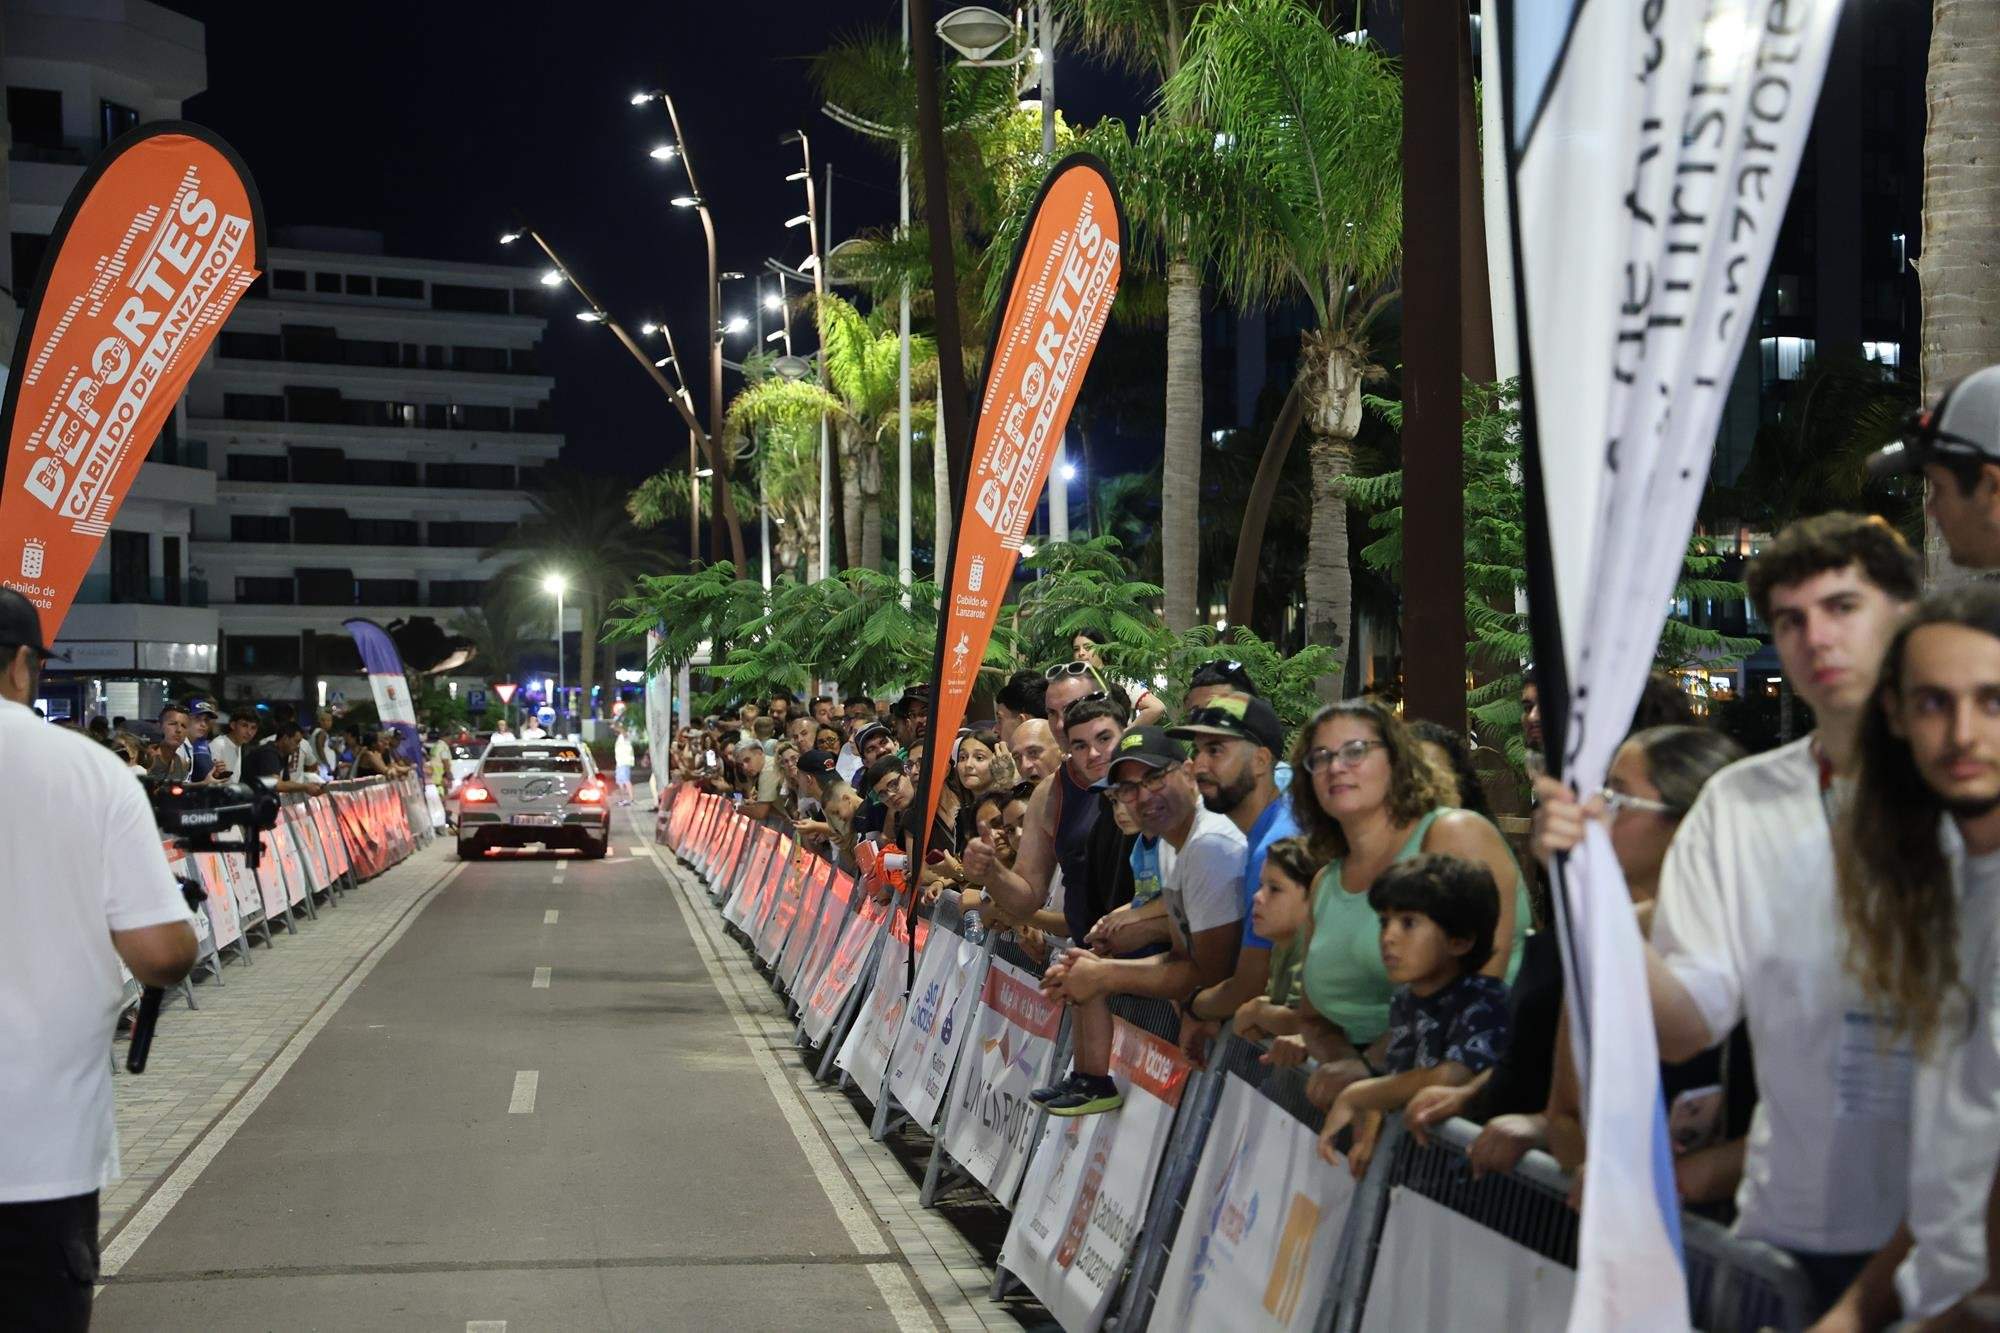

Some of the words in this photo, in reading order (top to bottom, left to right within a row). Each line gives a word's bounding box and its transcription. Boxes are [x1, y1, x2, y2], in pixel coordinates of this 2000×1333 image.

[24, 190, 217, 510] DEPORTES
[41, 420, 81, 487] SERVICIO
[76, 358, 115, 421] INSULAR
[110, 337, 128, 360] DE
[70, 402, 135, 516] CABILDO
[130, 361, 158, 401] DE
[159, 220, 242, 360] LANZAROTE
[975, 214, 1102, 528] DEPORTES
[1001, 423, 1044, 532] CABILDO
[1042, 383, 1060, 420] DE
[1057, 244, 1115, 382] LANZAROTE
[2, 579, 41, 595] Cabildo
[42, 586, 56, 597] de
[955, 605, 986, 619] Lanzarote
[956, 594, 979, 607] Cabildo
[979, 599, 989, 608] de
[181, 813, 218, 825] RONIN
